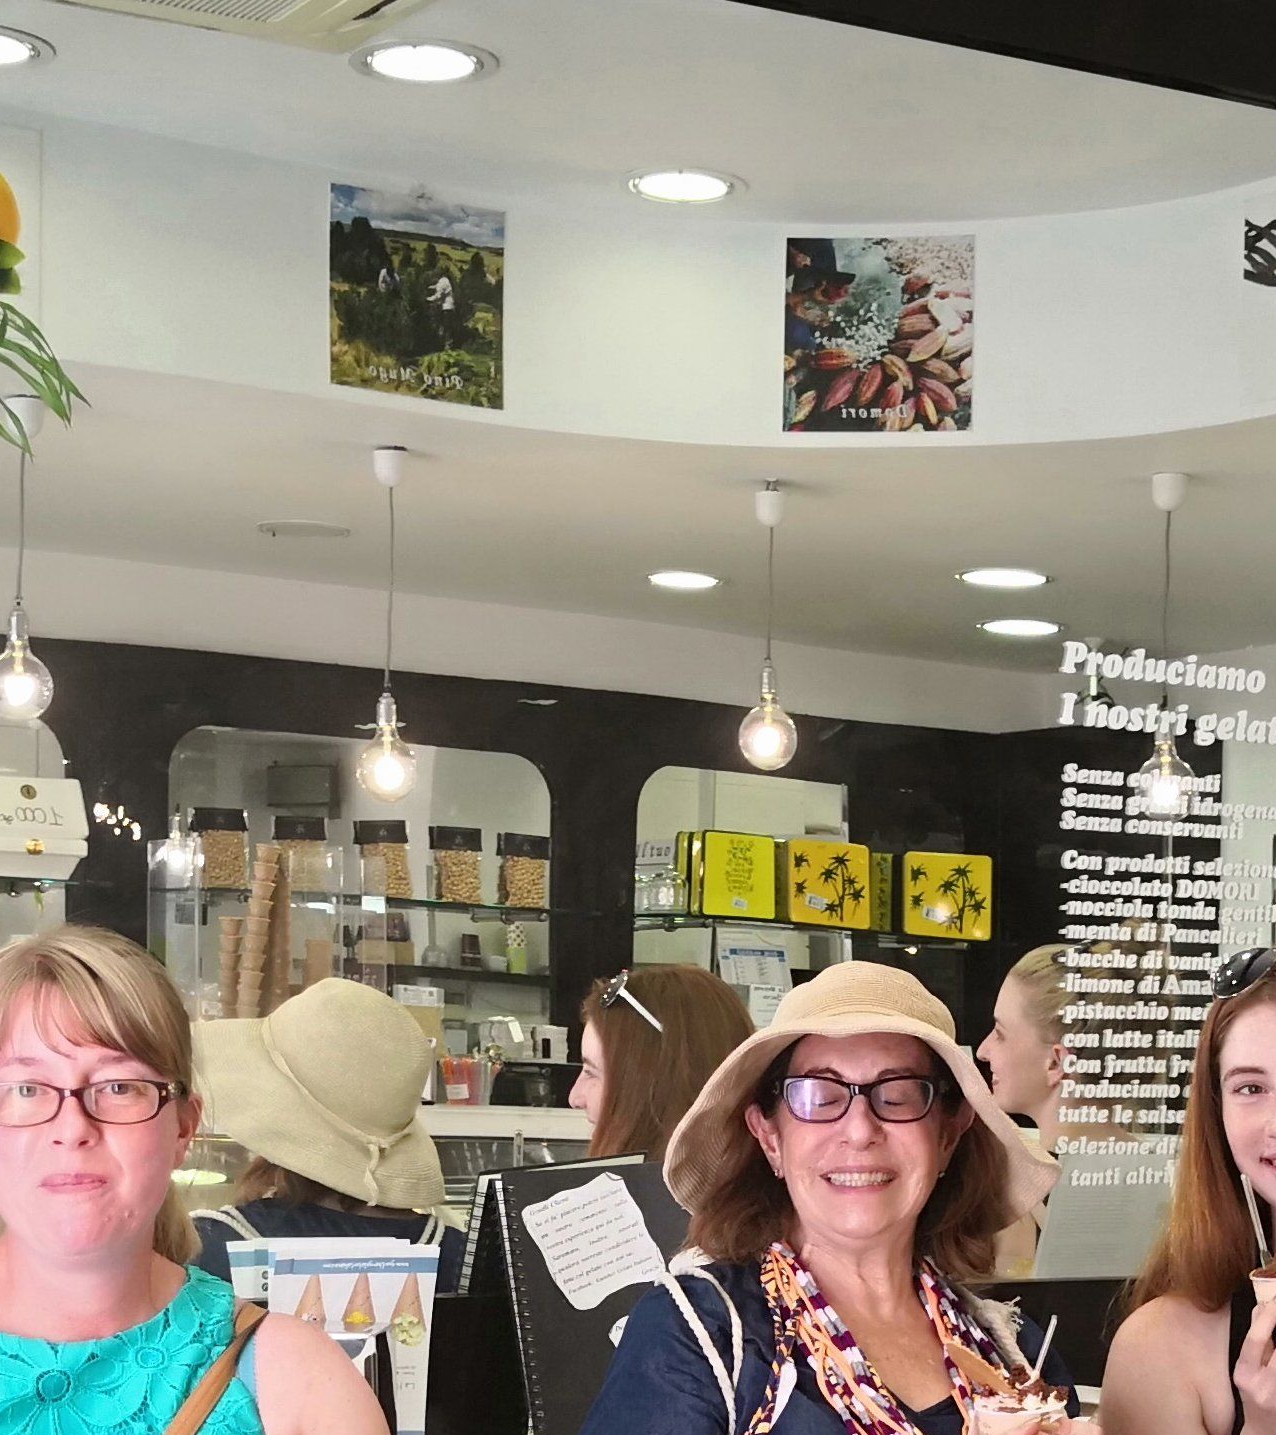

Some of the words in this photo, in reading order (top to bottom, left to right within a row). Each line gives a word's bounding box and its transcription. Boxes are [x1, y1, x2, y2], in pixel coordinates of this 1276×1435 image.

[1059, 641, 1266, 694] Produciamo
[1058, 692, 1078, 726] I
[1083, 700, 1190, 737] nostri
[1061, 763, 1124, 787] Senza
[1060, 787, 1124, 811] Senza
[1059, 809, 1123, 833] Senza
[1124, 817, 1244, 840] conservanti
[1060, 849, 1103, 870] Con
[1104, 853, 1191, 876] prodotti
[1060, 875, 1173, 898] -cioccolato
[1174, 878, 1262, 901] DOMORI
[1059, 898, 1155, 918] -nocciola
[1156, 901, 1217, 921] tonda
[1058, 922, 1132, 941] -menta
[1133, 922, 1158, 943] di
[1159, 923, 1263, 946] Pancalieri
[1057, 948, 1138, 970] -bacche
[1140, 950, 1163, 970] di
[1056, 972, 1135, 994] -limone
[1136, 974, 1161, 995] di
[1058, 1000, 1170, 1024] -pistacchio
[1062, 1031, 1100, 1049] con
[1102, 1028, 1153, 1049] latte
[1061, 1054, 1102, 1075] Con
[1103, 1054, 1167, 1078] frutta
[1060, 1078, 1181, 1099] Produciamo
[1058, 1105, 1110, 1124] tutte
[1111, 1104, 1133, 1125] le
[1055, 1135, 1151, 1156] Selezione
[1070, 1166, 1120, 1187] tanti
